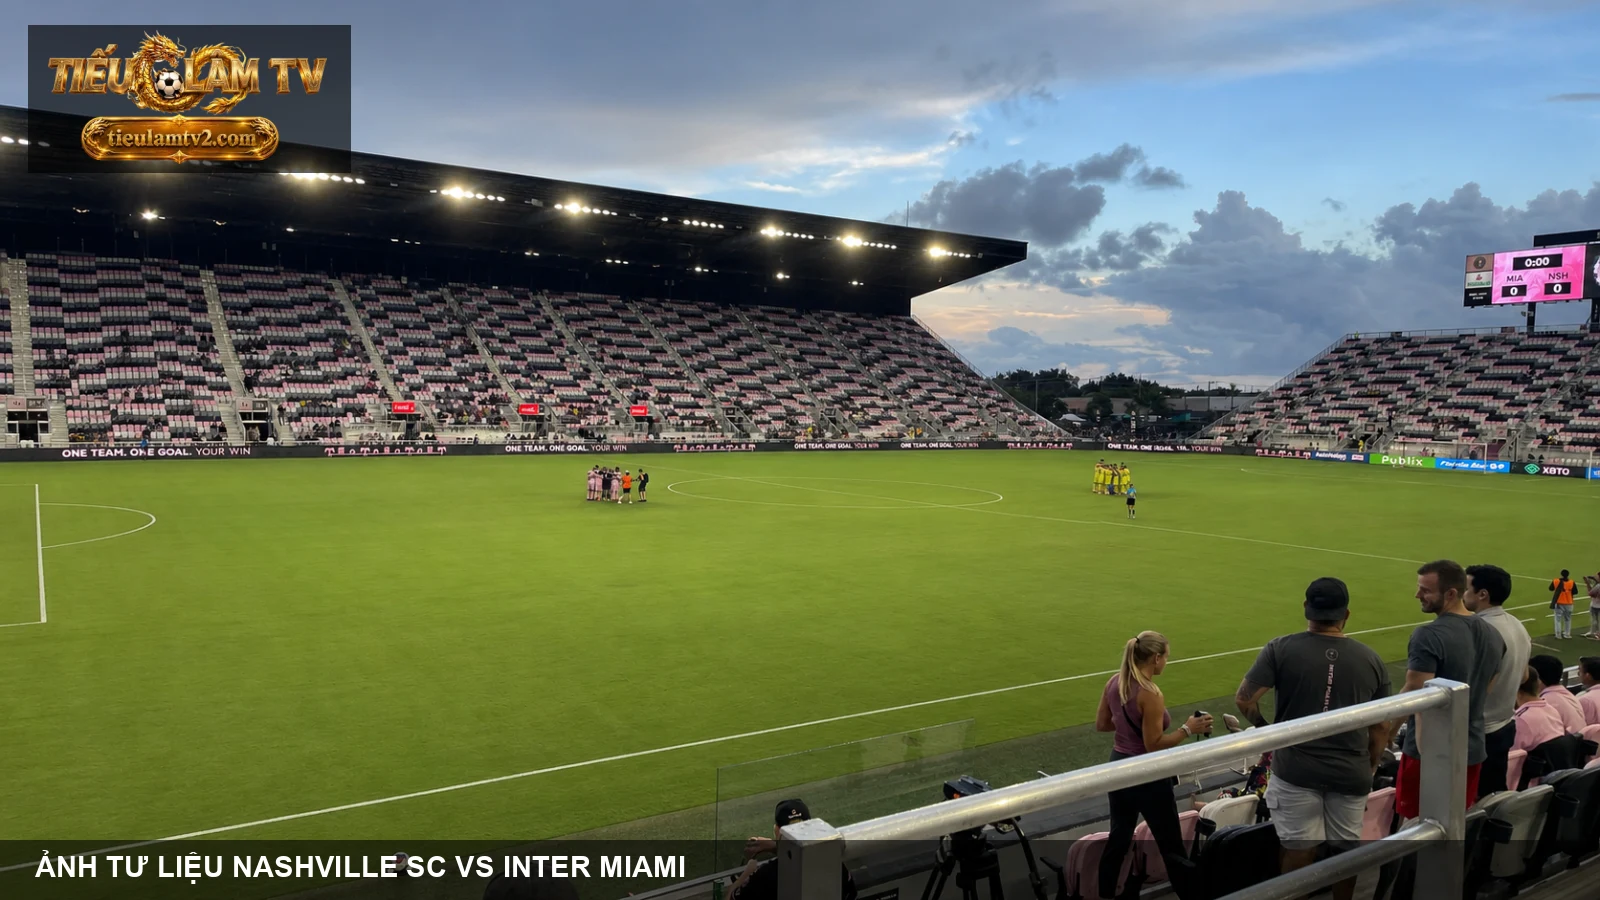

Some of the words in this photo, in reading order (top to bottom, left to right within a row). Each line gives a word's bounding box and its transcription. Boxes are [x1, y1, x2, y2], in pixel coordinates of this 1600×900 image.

[1524, 256, 1550, 268] 0:00
[1506, 274, 1524, 283] MIA
[1548, 272, 1569, 281] NSH
[1509, 286, 1519, 296] 0
[1553, 283, 1562, 294] 0
[61, 448, 88, 458] ONE
[90, 448, 128, 457] TEAM.
[157, 447, 193, 457] GOAL.
[195, 447, 225, 456] YOUR
[228, 447, 252, 456] WIN
[504, 444, 522, 453] ONE
[549, 444, 566, 452] ONE
[1381, 455, 1423, 466] Publix
[1542, 466, 1570, 476] XBTO
